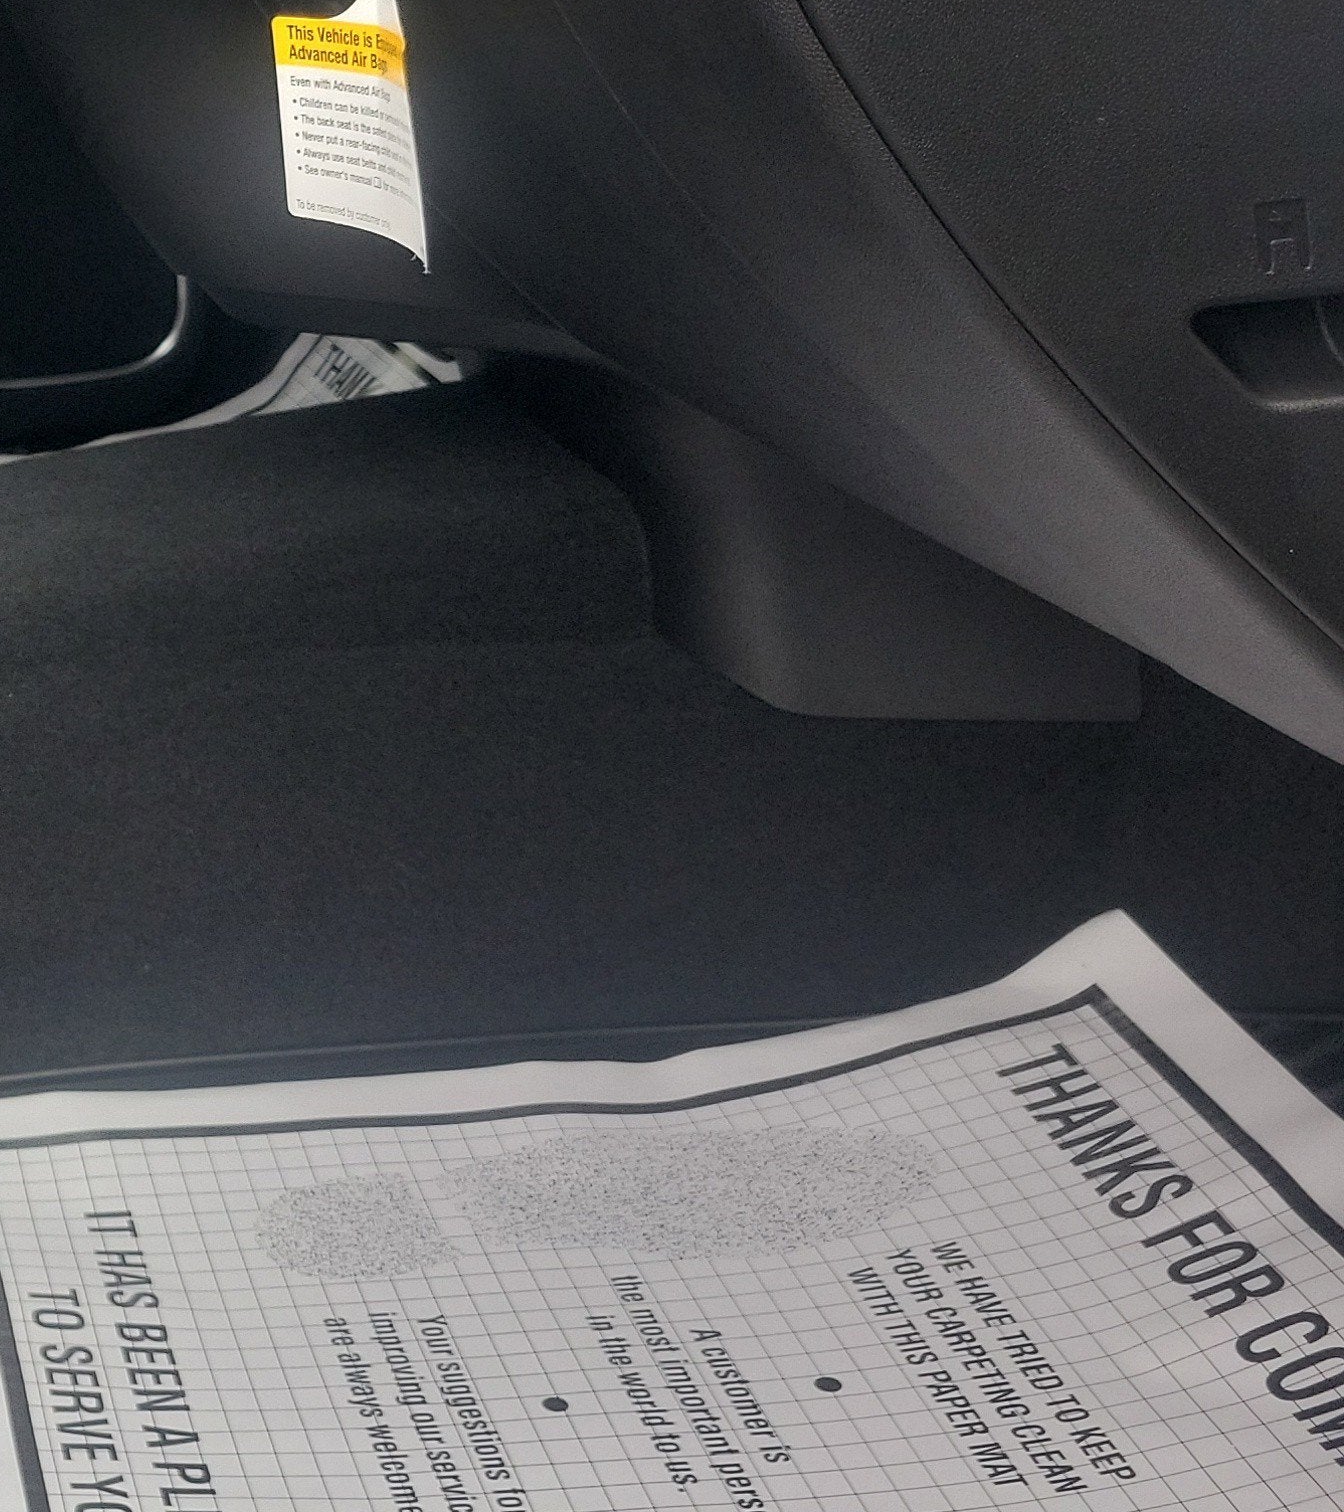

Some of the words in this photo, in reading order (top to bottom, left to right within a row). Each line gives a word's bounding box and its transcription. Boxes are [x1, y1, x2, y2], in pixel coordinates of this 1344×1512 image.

[286, 25, 314, 41] This
[317, 27, 360, 46] Vehicle
[363, 32, 372, 48] is
[290, 45, 348, 64] Advanced
[352, 51, 367, 67] Air
[290, 76, 310, 87] Even
[314, 79, 331, 89] with
[334, 81, 369, 95] Advanced
[300, 97, 332, 110] Children
[335, 103, 347, 112] can
[350, 104, 359, 114] be
[301, 114, 314, 125] The
[317, 117, 334, 127] back
[336, 120, 351, 130] seat
[353, 122, 359, 131] is
[361, 123, 370, 134] the
[302, 131, 324, 143] Never
[326, 135, 338, 145] put
[340, 138, 344, 146] a
[303, 148, 330, 161] Always
[332, 153, 344, 163] use
[346, 156, 360, 166] seat
[305, 165, 319, 175] See
[321, 168, 348, 181] owner's
[296, 199, 305, 209] To
[307, 200, 315, 211] be
[317, 202, 345, 216] removed
[347, 207, 354, 220] by
[996, 1043, 1192, 1219] THANKS
[1142, 1210, 1285, 1318] FOR
[83, 1210, 138, 1237] IT
[93, 1250, 159, 1308] HAS
[28, 1288, 85, 1330] TO
[584, 1314, 617, 1333] in
[323, 1317, 354, 1346] are
[689, 1328, 721, 1342] A
[368, 1311, 427, 1406] improving
[598, 1334, 632, 1366] the
[932, 1241, 973, 1276] WE
[956, 1275, 1017, 1329] HAVE
[999, 1329, 1065, 1391] TRIED
[1046, 1393, 1089, 1424] TO
[1070, 1423, 1136, 1481] KEEP
[115, 1323, 191, 1411] BEEN
[849, 1267, 901, 1317] WITH
[885, 1320, 938, 1367] THIS
[919, 1369, 990, 1438] PAPER
[969, 1441, 1030, 1489] MAT
[886, 1248, 944, 1305] YOUR
[925, 1307, 1031, 1421] CARPETING
[1012, 1423, 1088, 1494] CLEAN
[337, 1352, 383, 1419] always
[611, 1274, 644, 1303] the
[630, 1309, 673, 1353] most
[659, 1356, 740, 1457] important
[715, 1461, 766, 1512] pers
[618, 1372, 673, 1429] world
[699, 1345, 779, 1442] customer
[39, 1344, 119, 1461] SERVE
[417, 1313, 454, 1356] Your
[436, 1360, 510, 1481] suggestions
[492, 1487, 526, 1512] fo
[142, 1425, 200, 1448] A
[408, 1412, 444, 1449] our
[652, 1432, 683, 1453] to
[763, 1444, 791, 1465] is
[151, 1461, 222, 1512] PL
[425, 1451, 474, 1512] servic
[664, 1461, 698, 1494] us.
